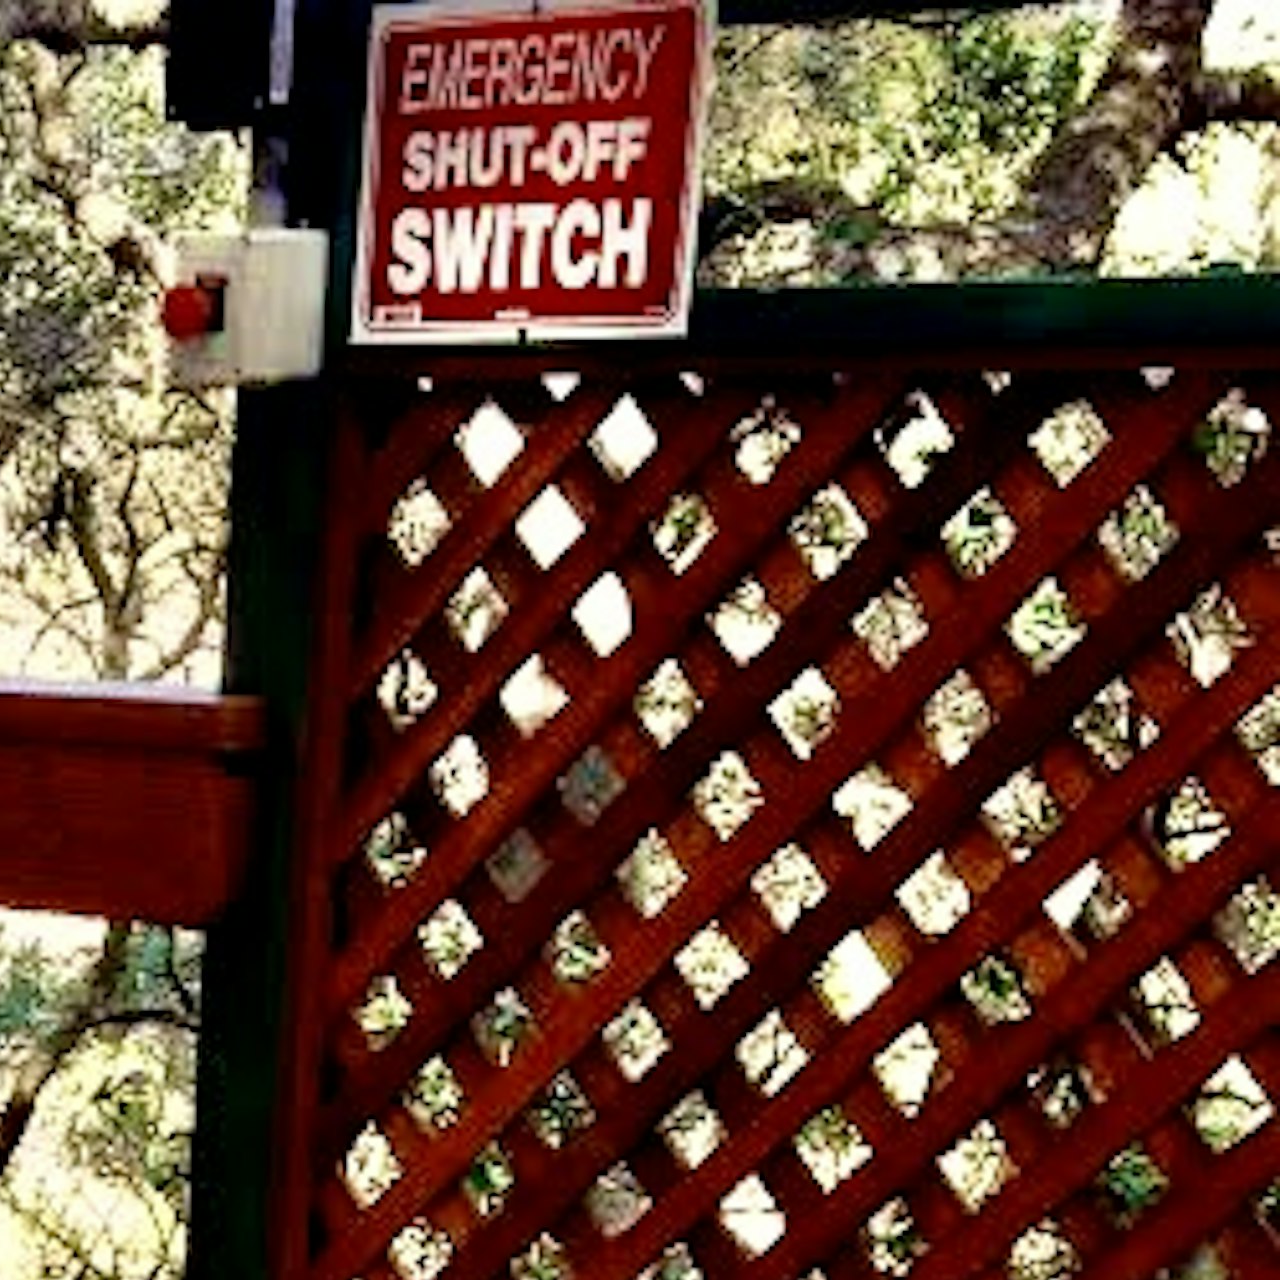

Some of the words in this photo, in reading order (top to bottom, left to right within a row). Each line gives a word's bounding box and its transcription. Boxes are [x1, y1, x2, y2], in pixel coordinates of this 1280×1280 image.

[398, 25, 666, 115] EMERGENCY
[401, 117, 652, 192] SHUT-OFF
[387, 198, 652, 294] SWITCH
